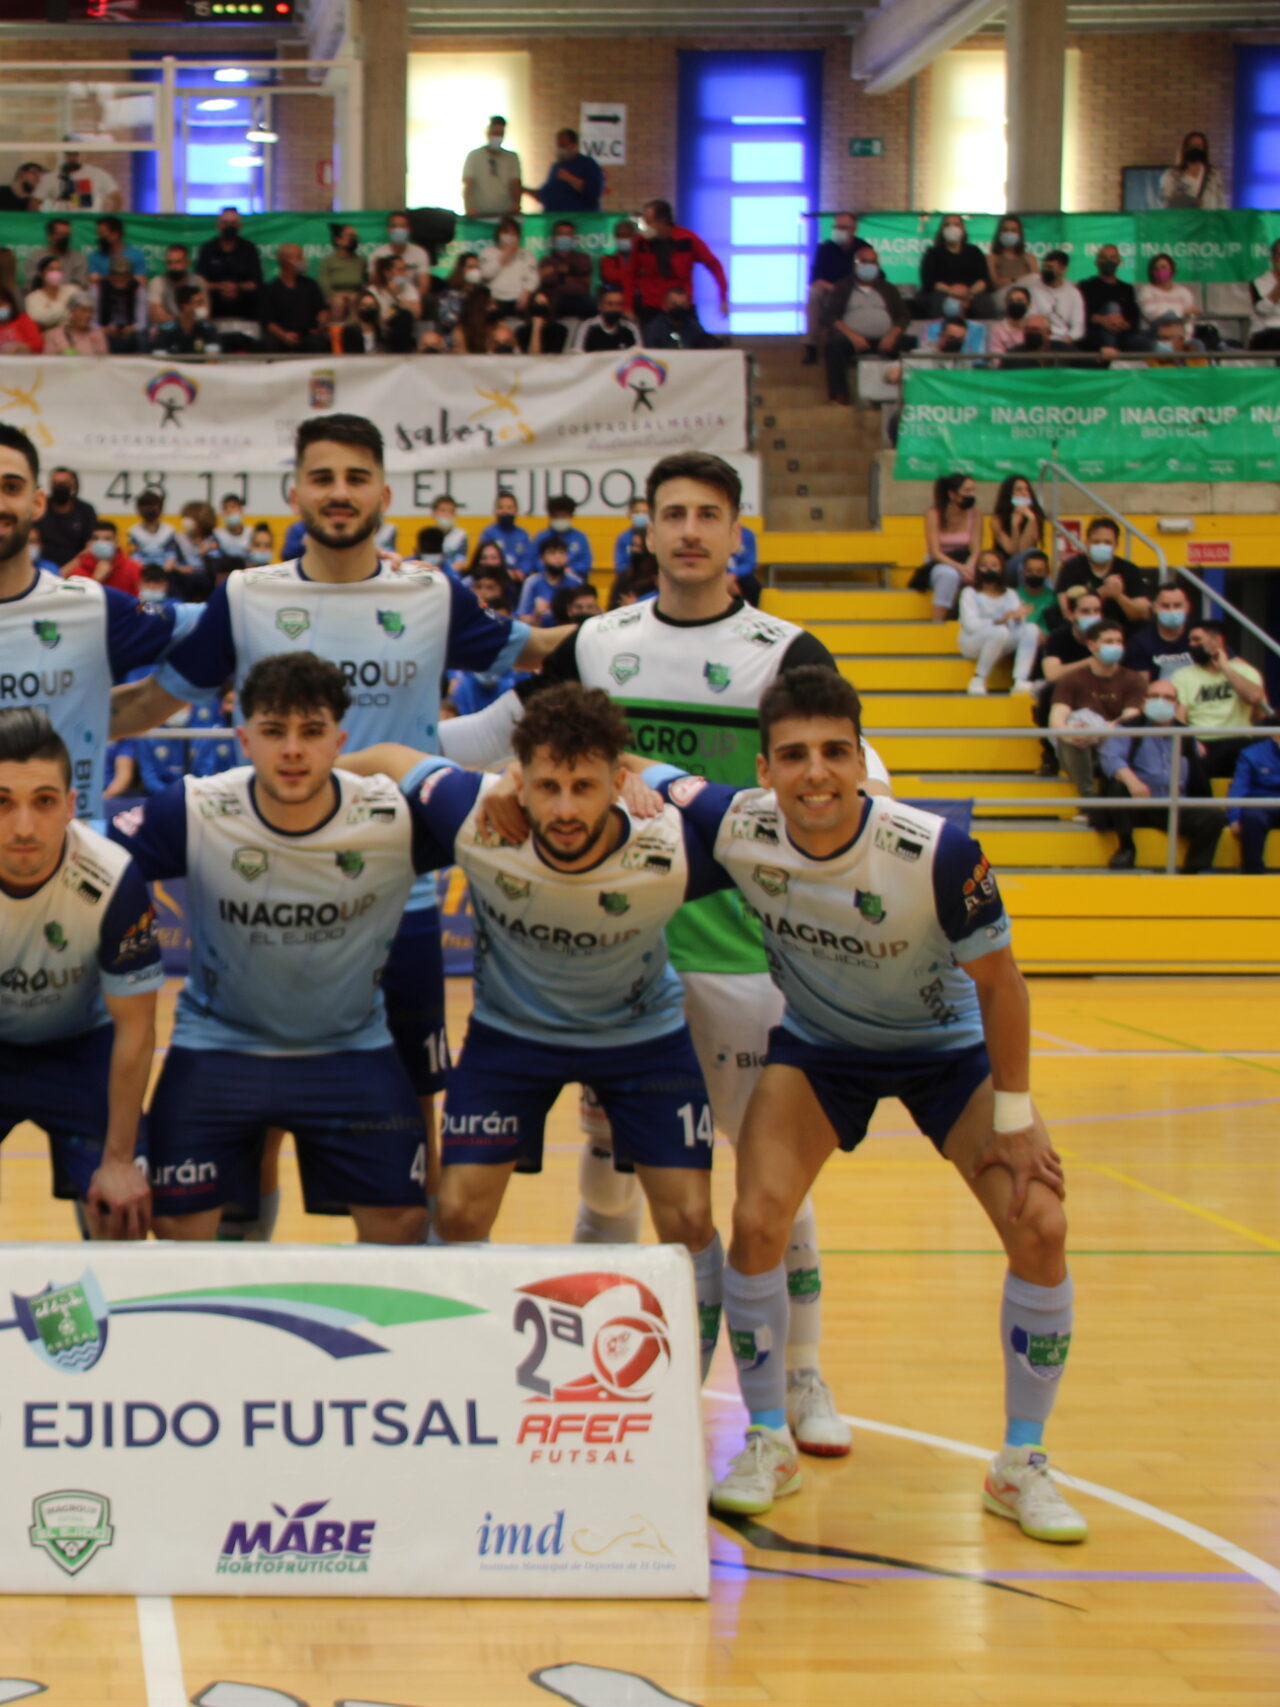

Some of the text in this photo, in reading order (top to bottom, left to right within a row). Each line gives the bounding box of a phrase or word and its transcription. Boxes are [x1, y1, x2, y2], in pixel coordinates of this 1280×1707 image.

[901, 404, 979, 424] GROUP
[991, 406, 1108, 425] INAGROUP
[1121, 406, 1240, 425] INAGROUP
[413, 469, 467, 508] EL
[496, 469, 636, 515] EJIDO
[330, 660, 418, 688] ROUP
[624, 724, 739, 759] AGROUP
[220, 892, 377, 928] INAGROUP
[23, 1400, 220, 1449] EJIDO
[243, 1397, 499, 1447] FUTSAL
[516, 1412, 653, 1445] AFEF
[529, 1449, 636, 1465] FUTSAL
[476, 1509, 566, 1556] imd
